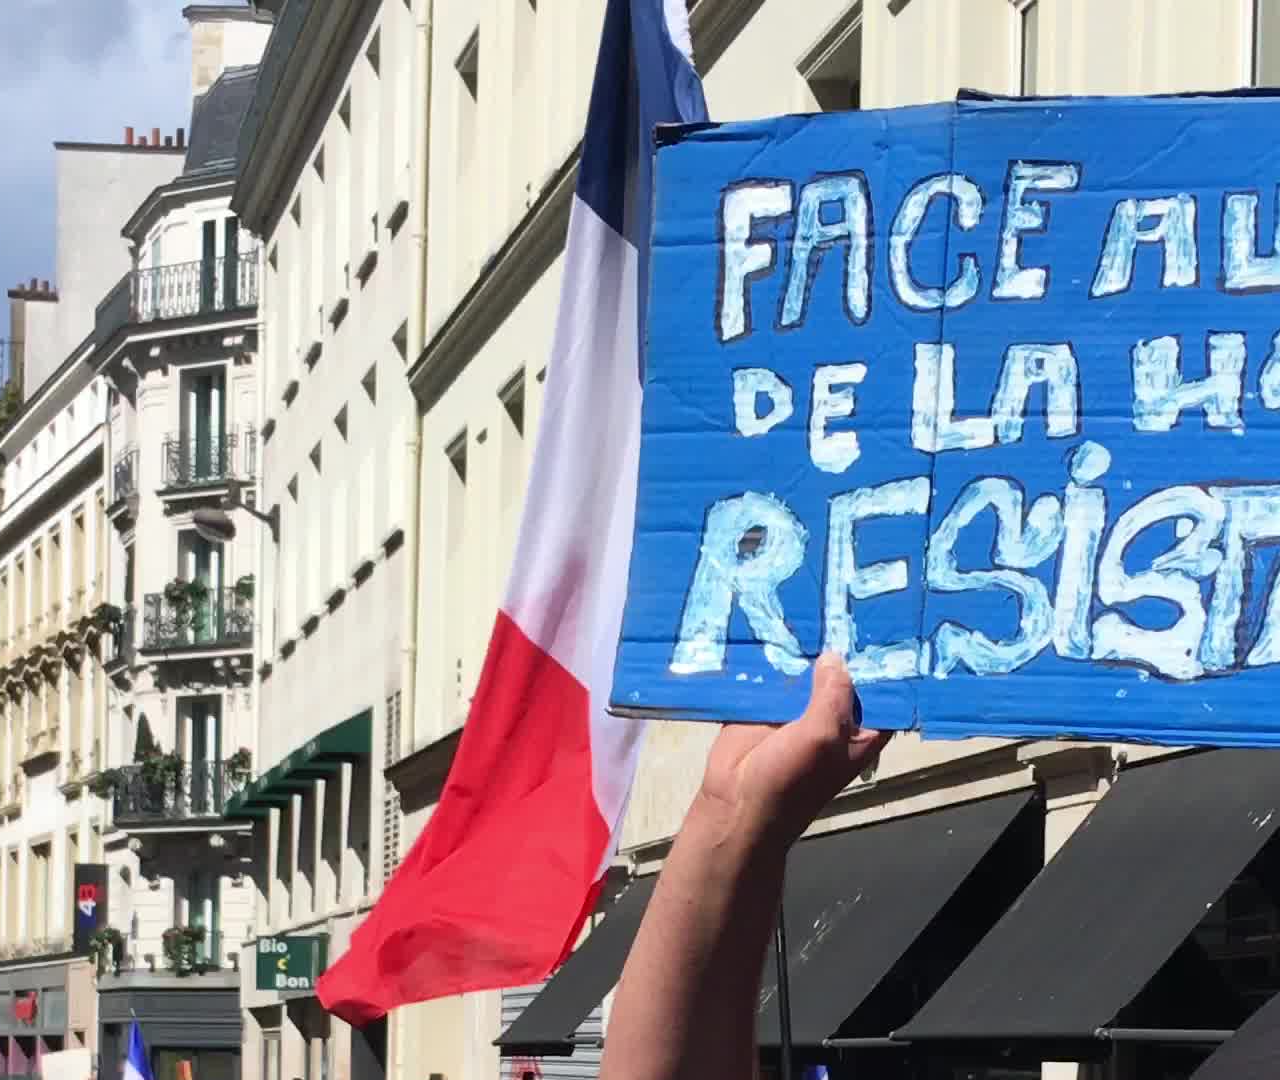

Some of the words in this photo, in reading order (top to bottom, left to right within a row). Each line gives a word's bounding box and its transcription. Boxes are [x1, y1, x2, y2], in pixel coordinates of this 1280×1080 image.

[718, 160, 1082, 343] FACE
[731, 360, 868, 474] DE
[911, 340, 1082, 454] LA
[260, 938, 288, 953] Bio
[275, 973, 310, 988] Bon
